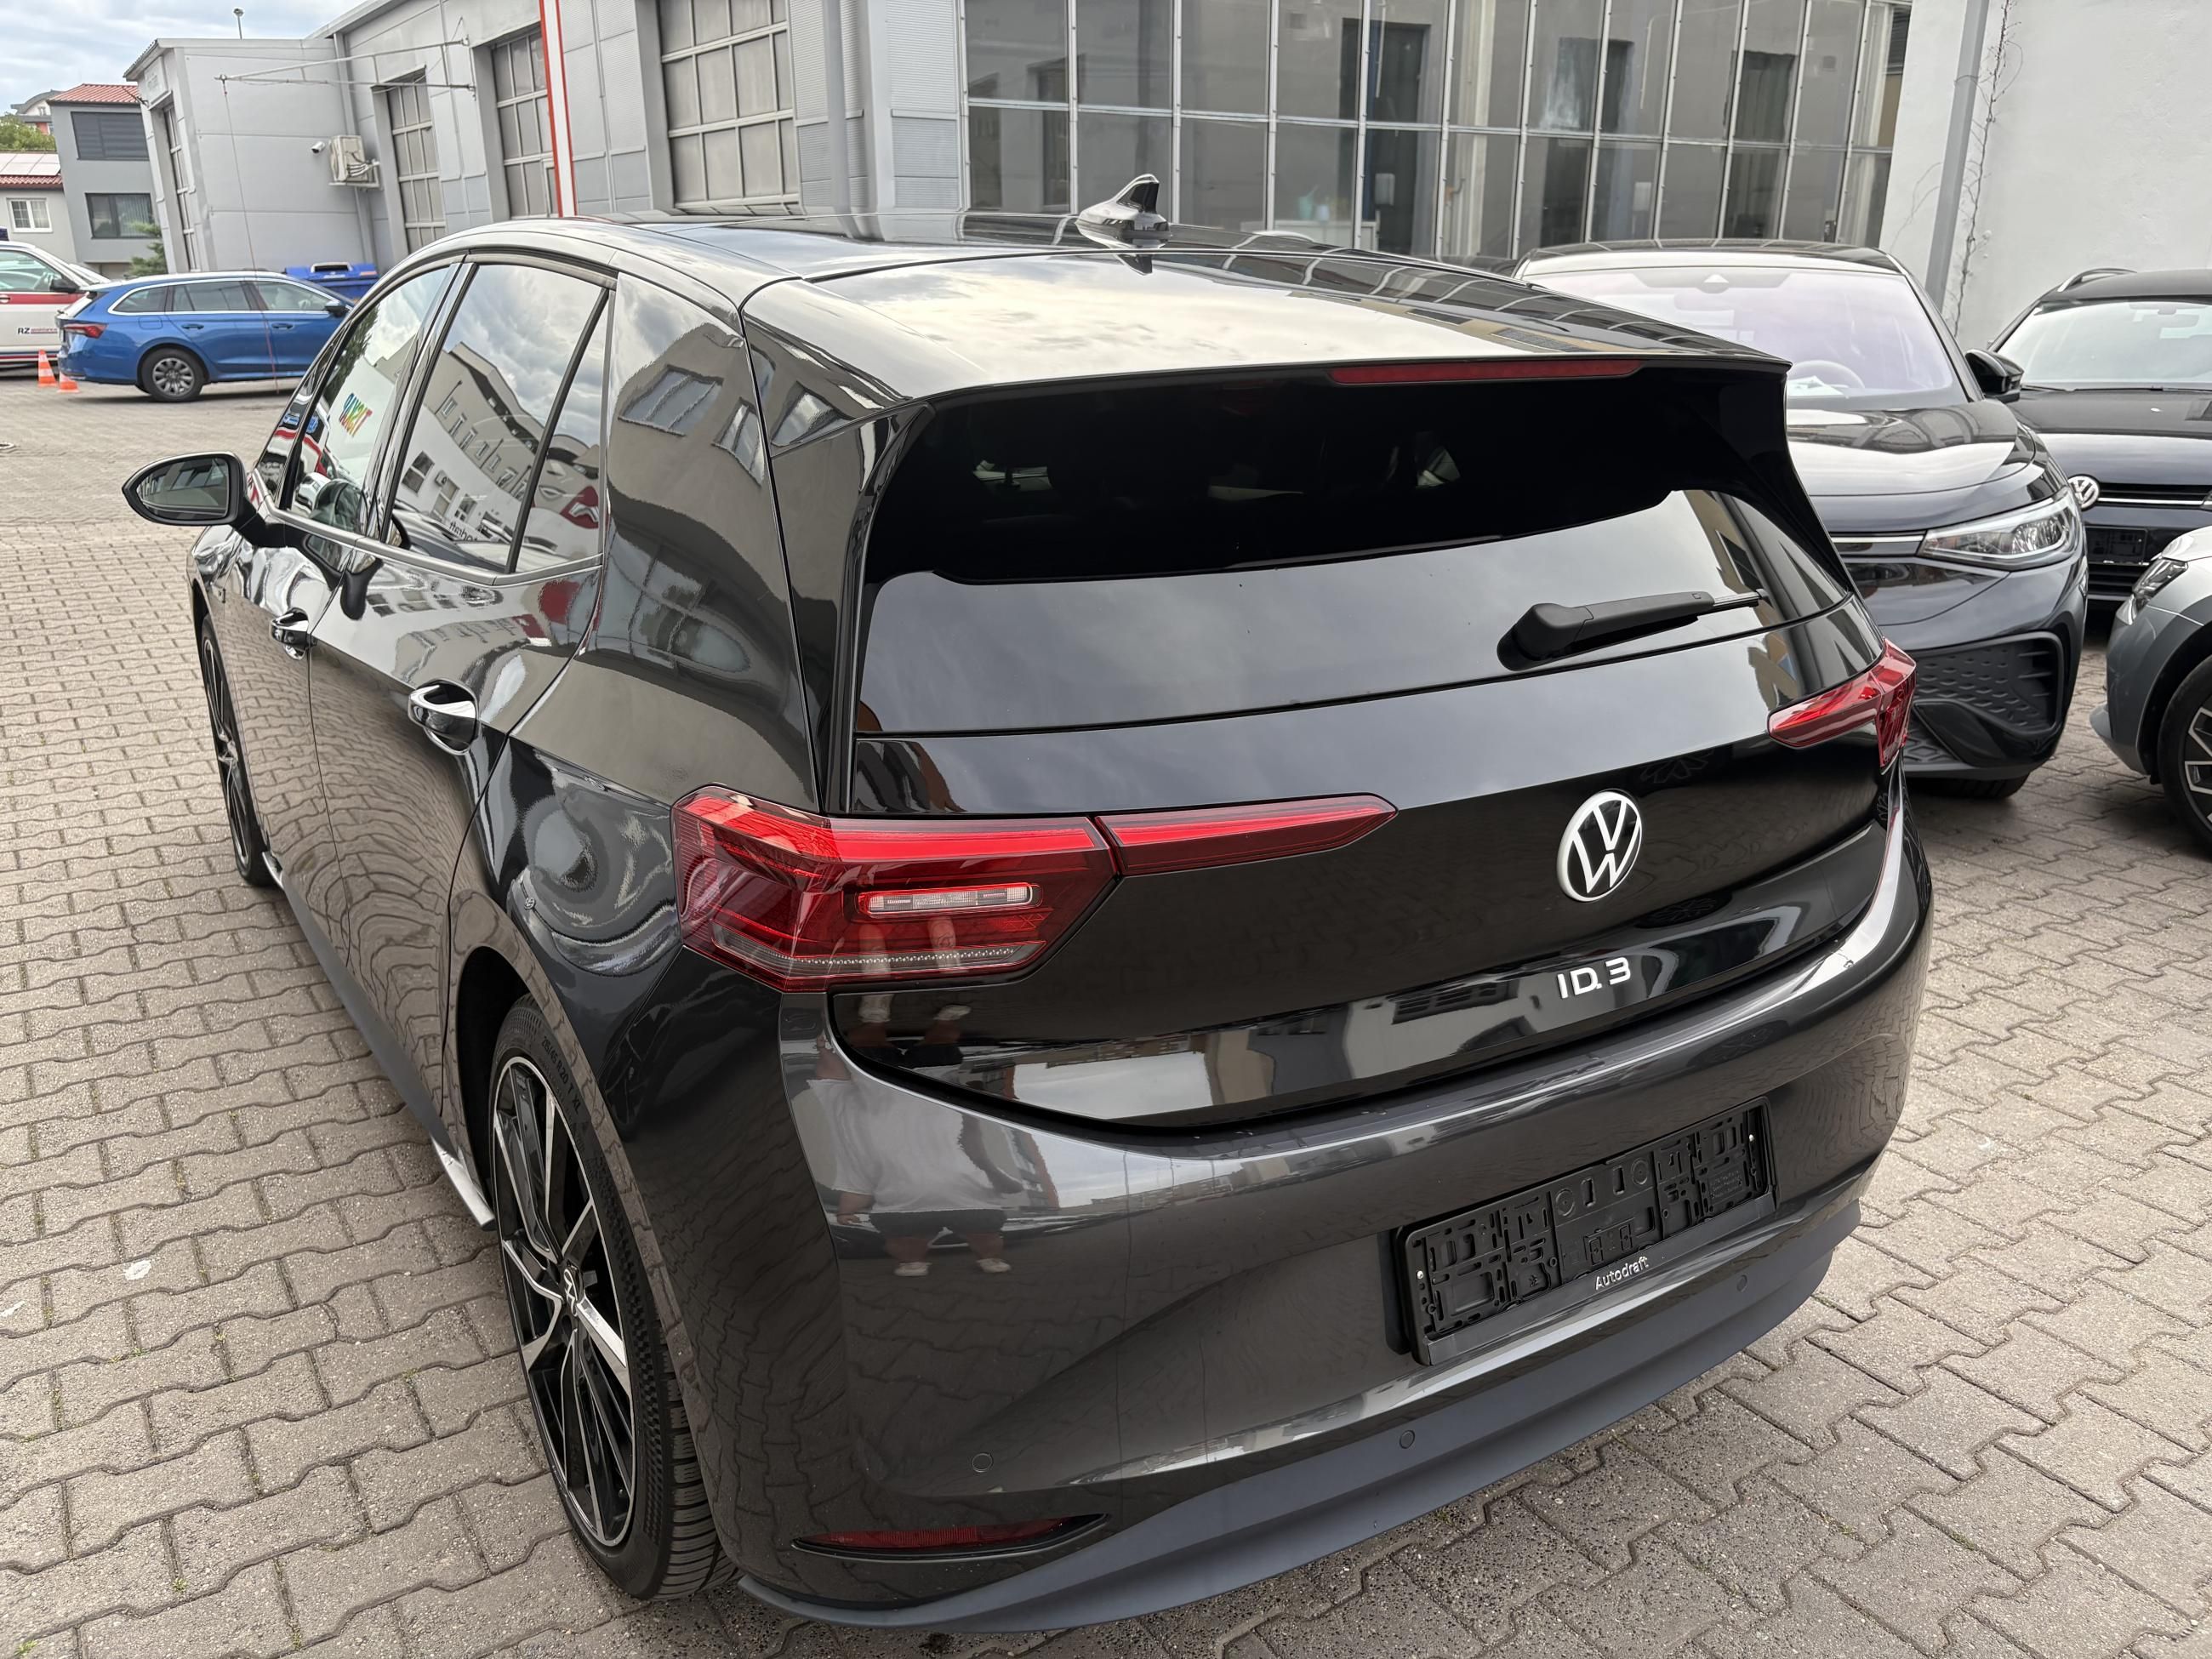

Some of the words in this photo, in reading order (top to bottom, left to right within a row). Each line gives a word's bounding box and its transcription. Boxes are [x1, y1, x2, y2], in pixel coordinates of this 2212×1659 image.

[1559, 791, 1642, 901] VW
[1557, 956, 1631, 999] ID.3
[1595, 1256, 1650, 1291] Autodraft
